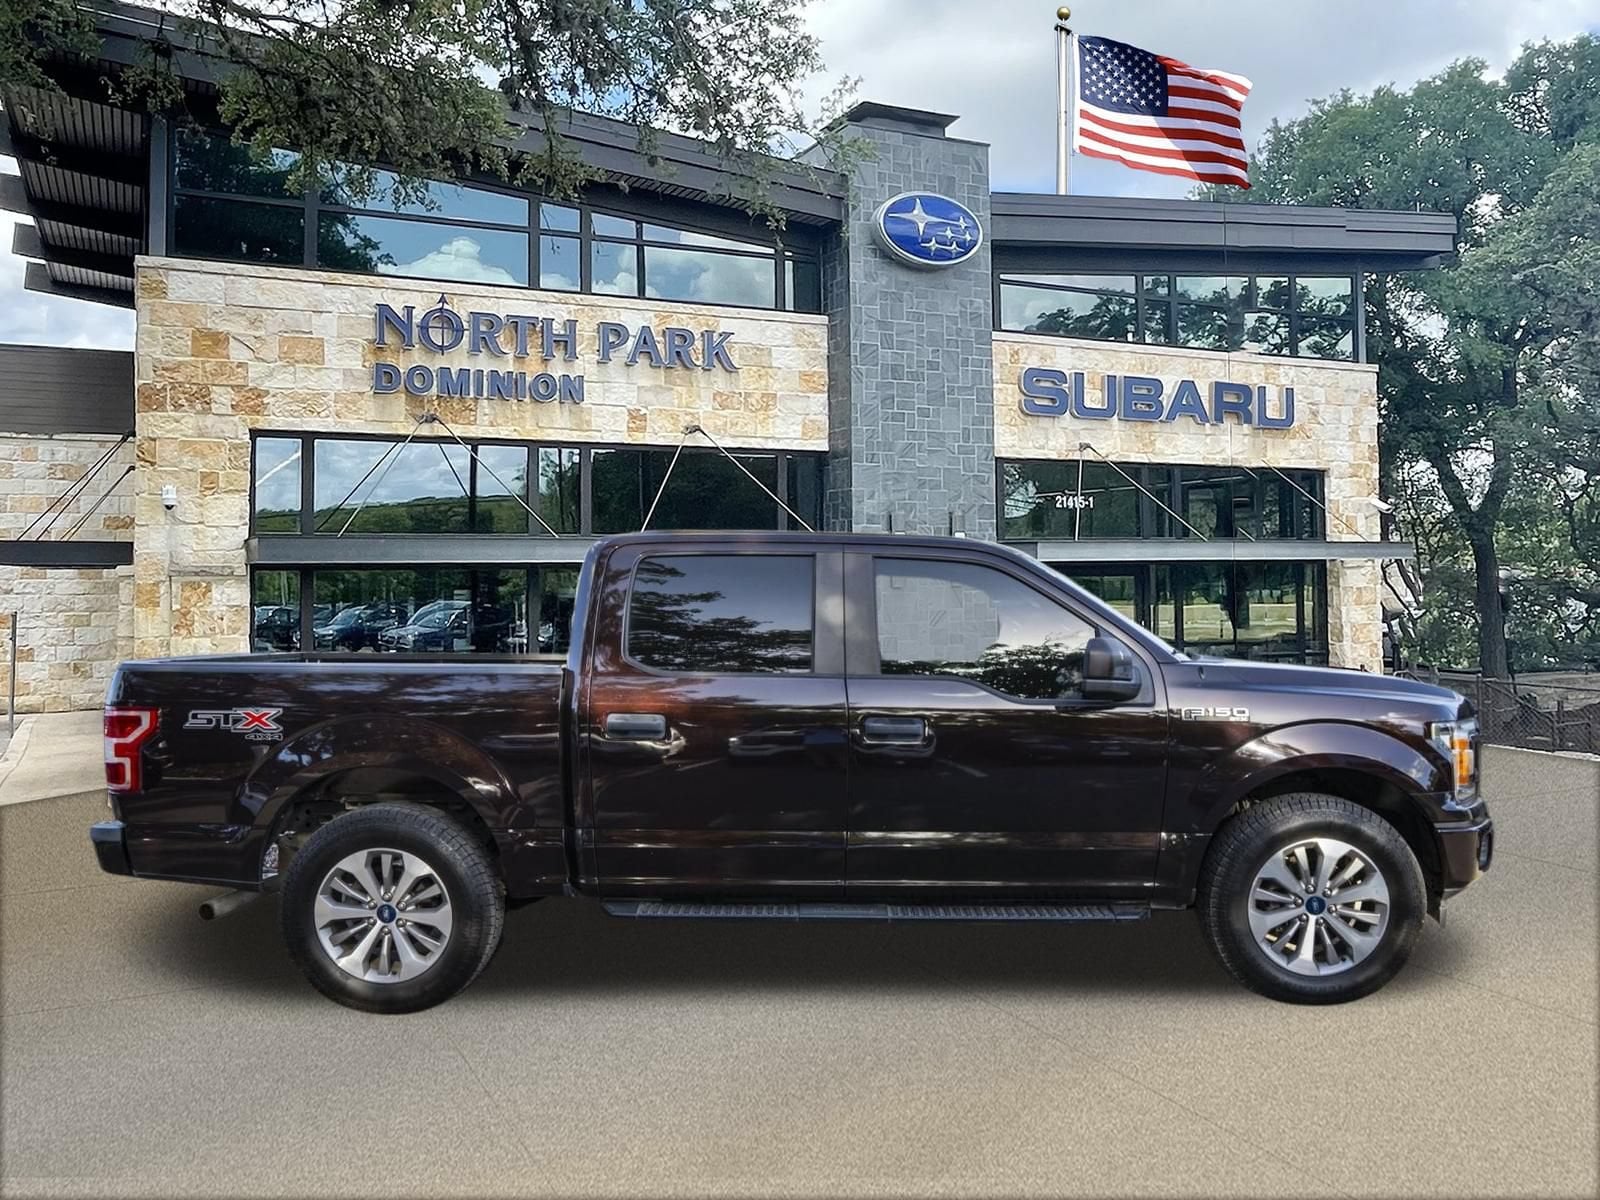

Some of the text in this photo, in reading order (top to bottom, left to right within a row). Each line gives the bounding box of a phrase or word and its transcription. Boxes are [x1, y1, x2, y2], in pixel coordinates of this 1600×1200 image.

[374, 302, 742, 372] NORTH PARK
[373, 362, 586, 404] DOMINION
[1018, 367, 1296, 430] SUBARU
[183, 707, 283, 732] STX
